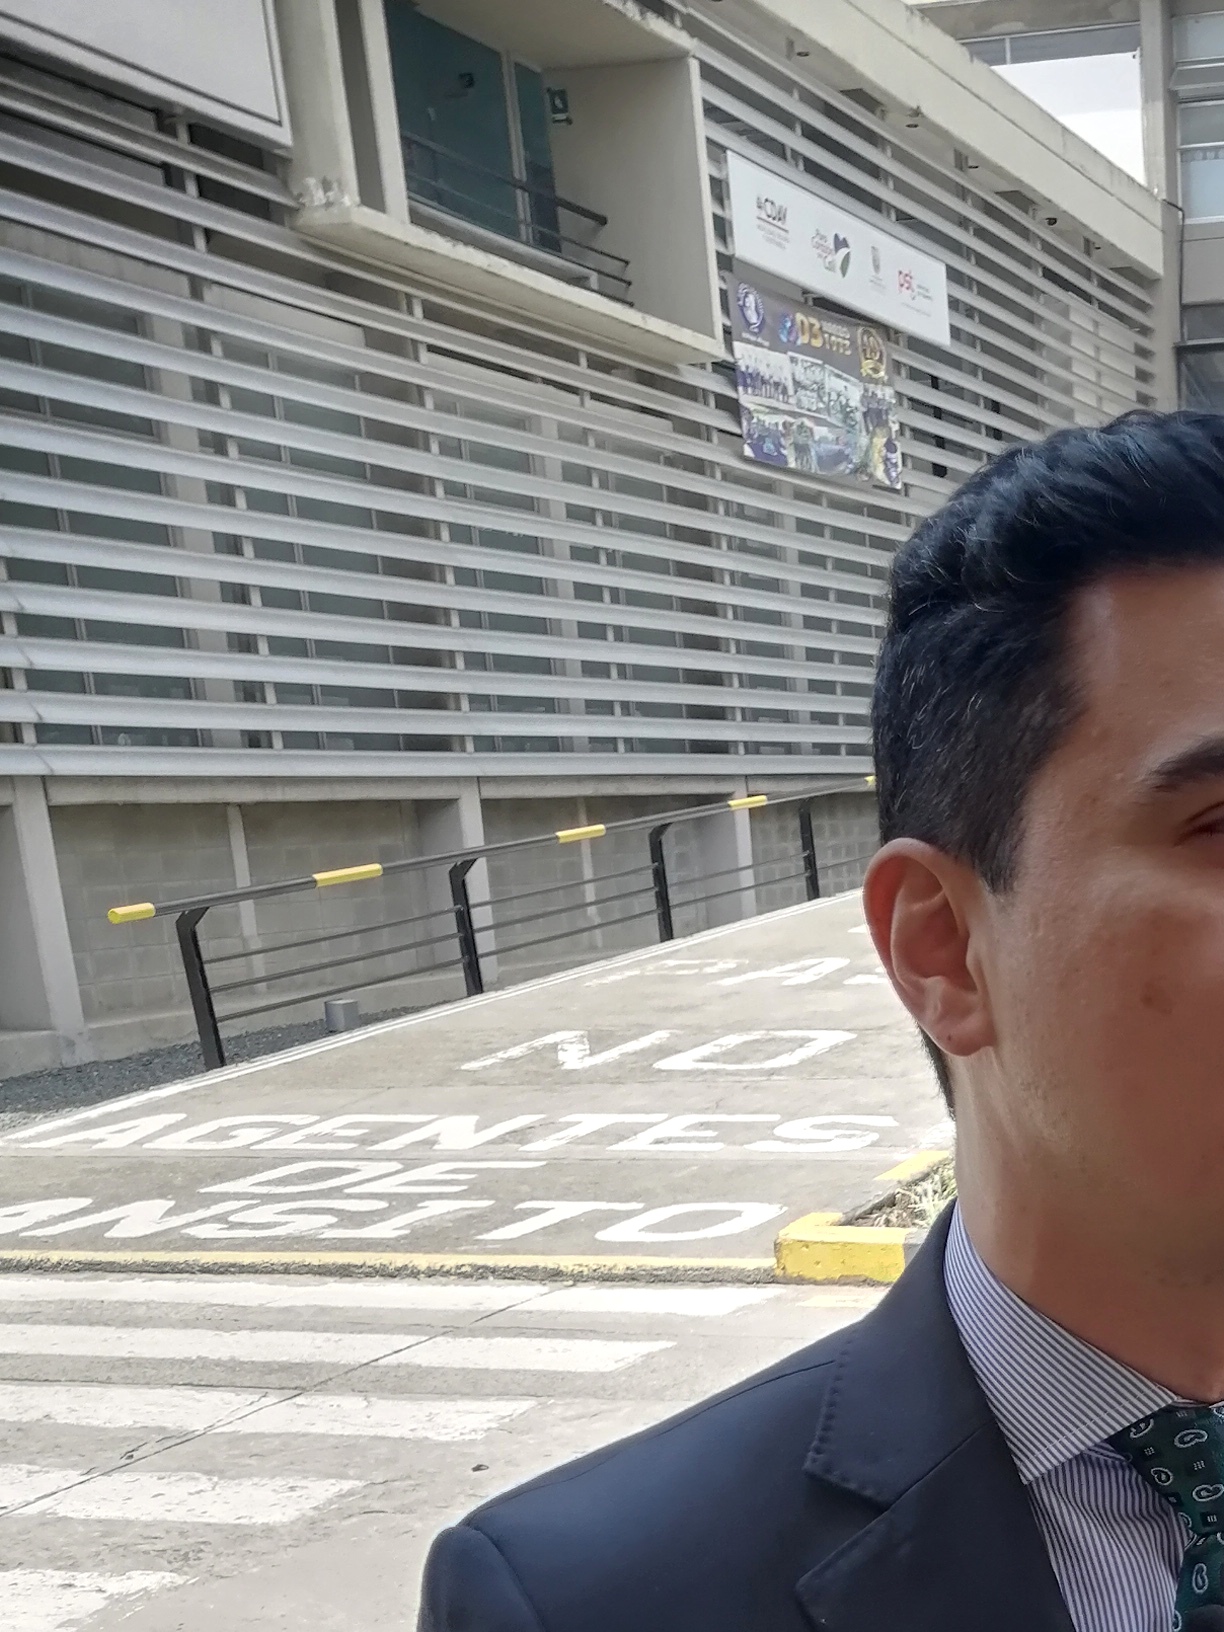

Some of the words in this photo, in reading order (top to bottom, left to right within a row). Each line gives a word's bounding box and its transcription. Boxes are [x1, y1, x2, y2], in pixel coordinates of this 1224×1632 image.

[459, 1029, 858, 1070] NO
[18, 1113, 900, 1153] AGENTES
[196, 1160, 548, 1194] DE
